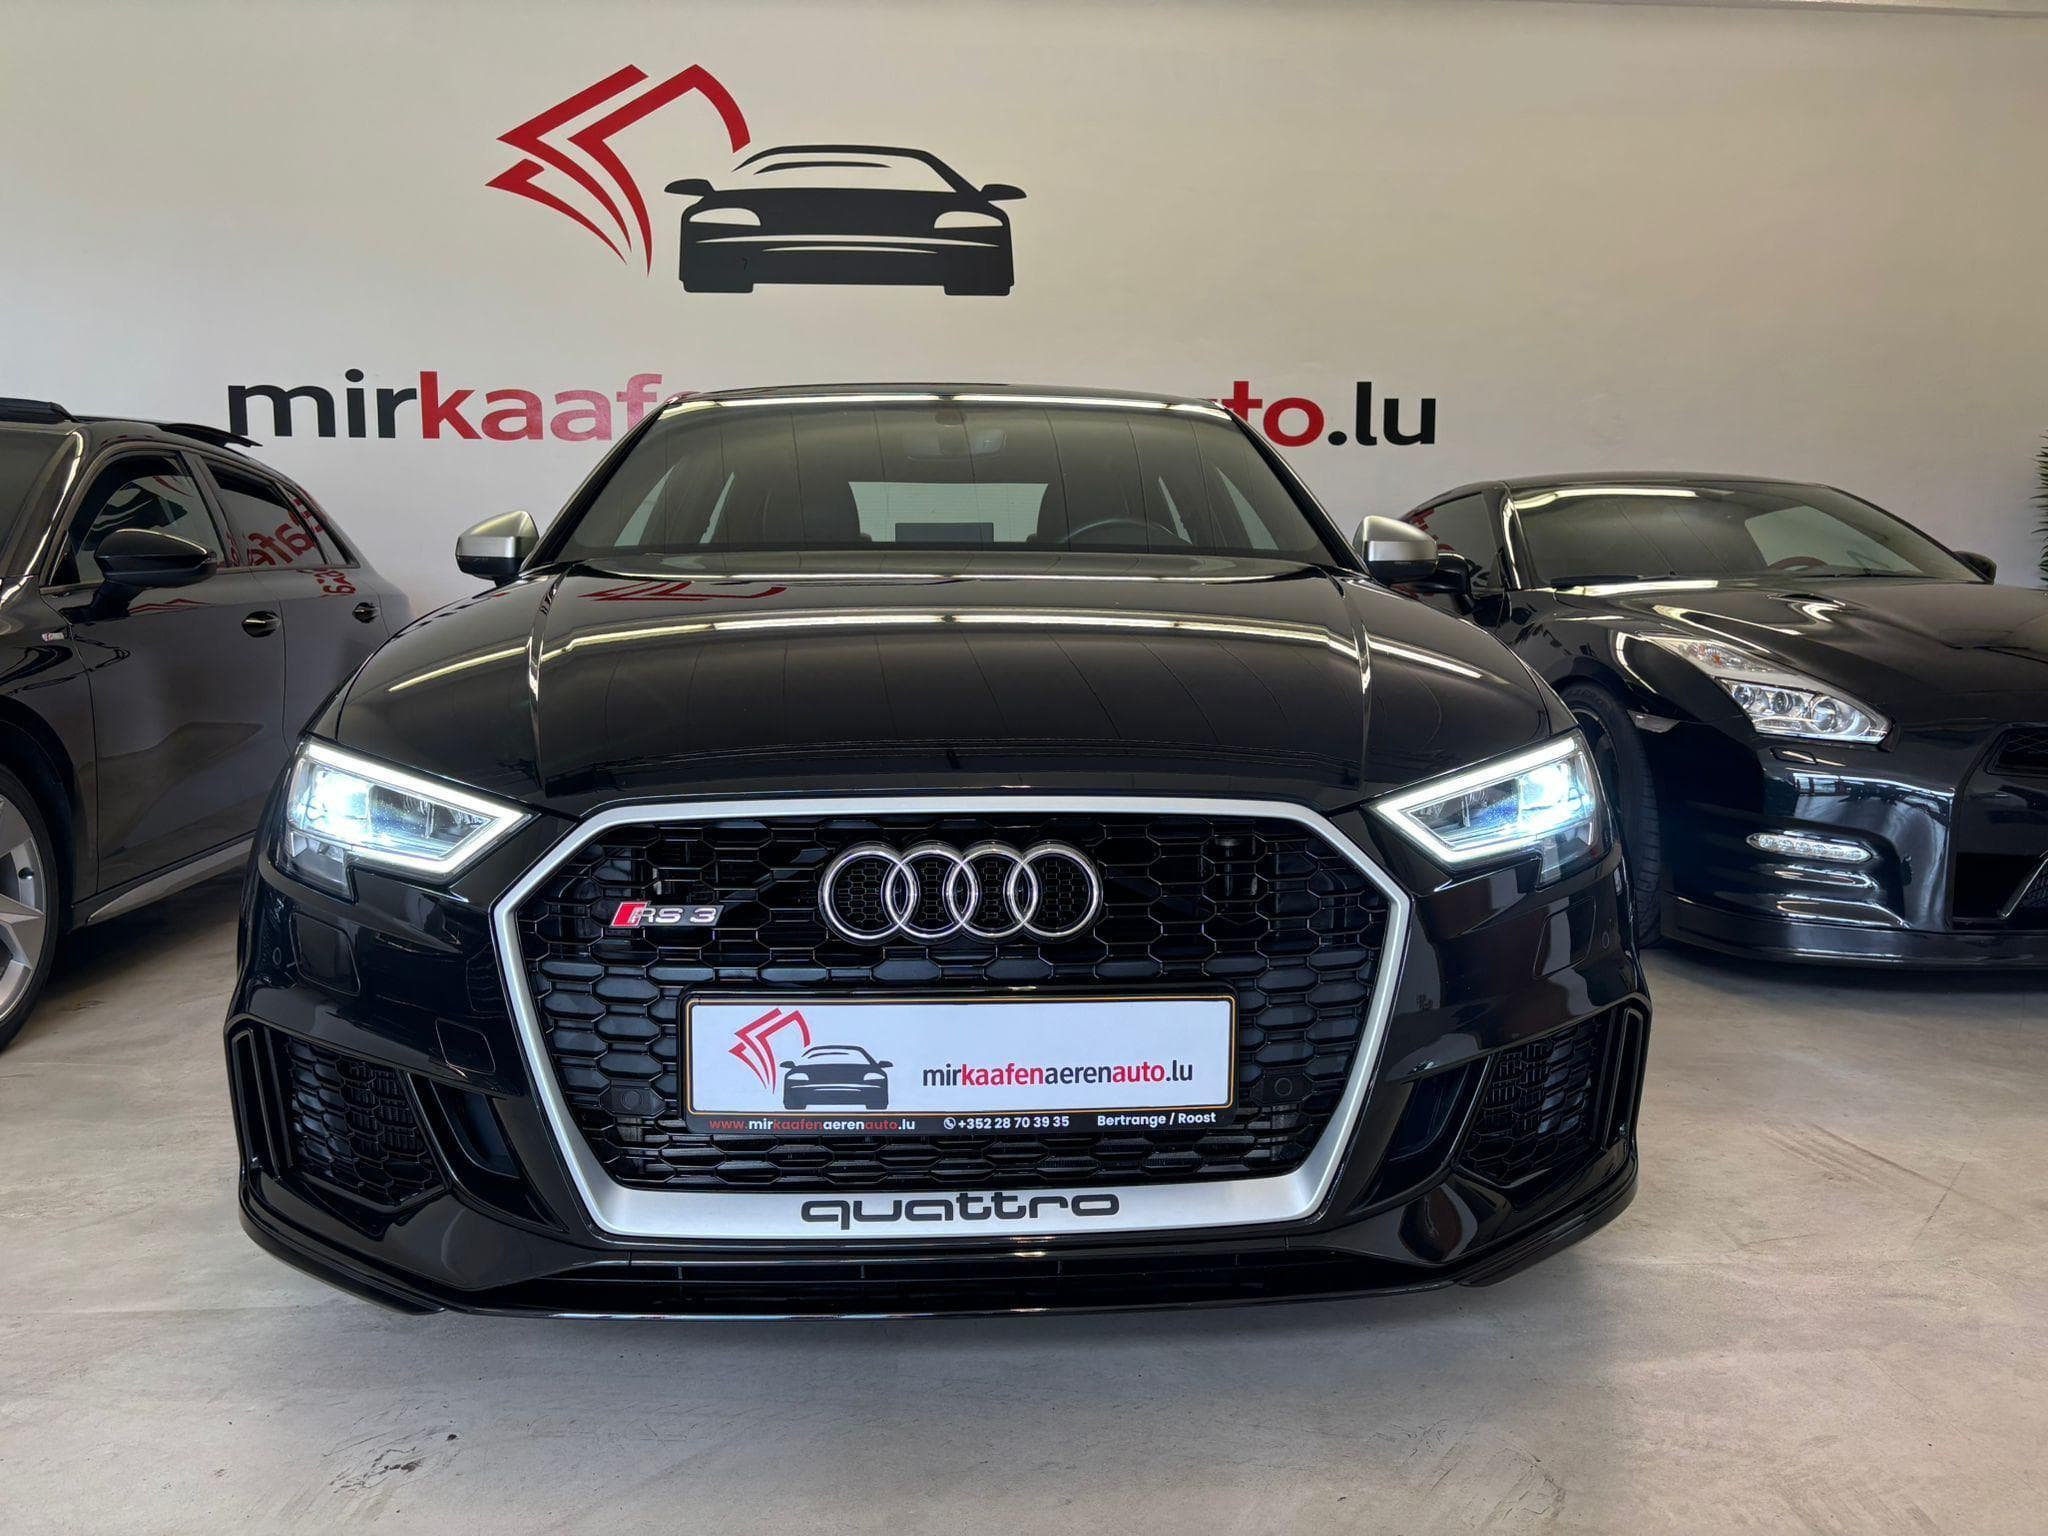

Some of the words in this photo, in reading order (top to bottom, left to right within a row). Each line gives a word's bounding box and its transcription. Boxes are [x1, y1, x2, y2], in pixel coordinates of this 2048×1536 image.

[228, 370, 701, 442] mirkaaf
[1205, 380, 1437, 447] to.lu
[627, 906, 684, 924] RS
[690, 907, 717, 923] 3
[922, 1059, 1193, 1087] mirkaafenaerenauto.lu
[708, 1117, 916, 1132] www.mirkaafenaerenauto.lu
[957, 1117, 992, 1130] +352
[994, 1117, 1011, 1130] 28
[1014, 1116, 1031, 1129] 70
[1033, 1116, 1050, 1129] 39
[1052, 1115, 1070, 1128] 35
[1097, 1113, 1167, 1128] Bertrange
[1177, 1111, 1217, 1125] Roost
[800, 1191, 1121, 1231] quattro
